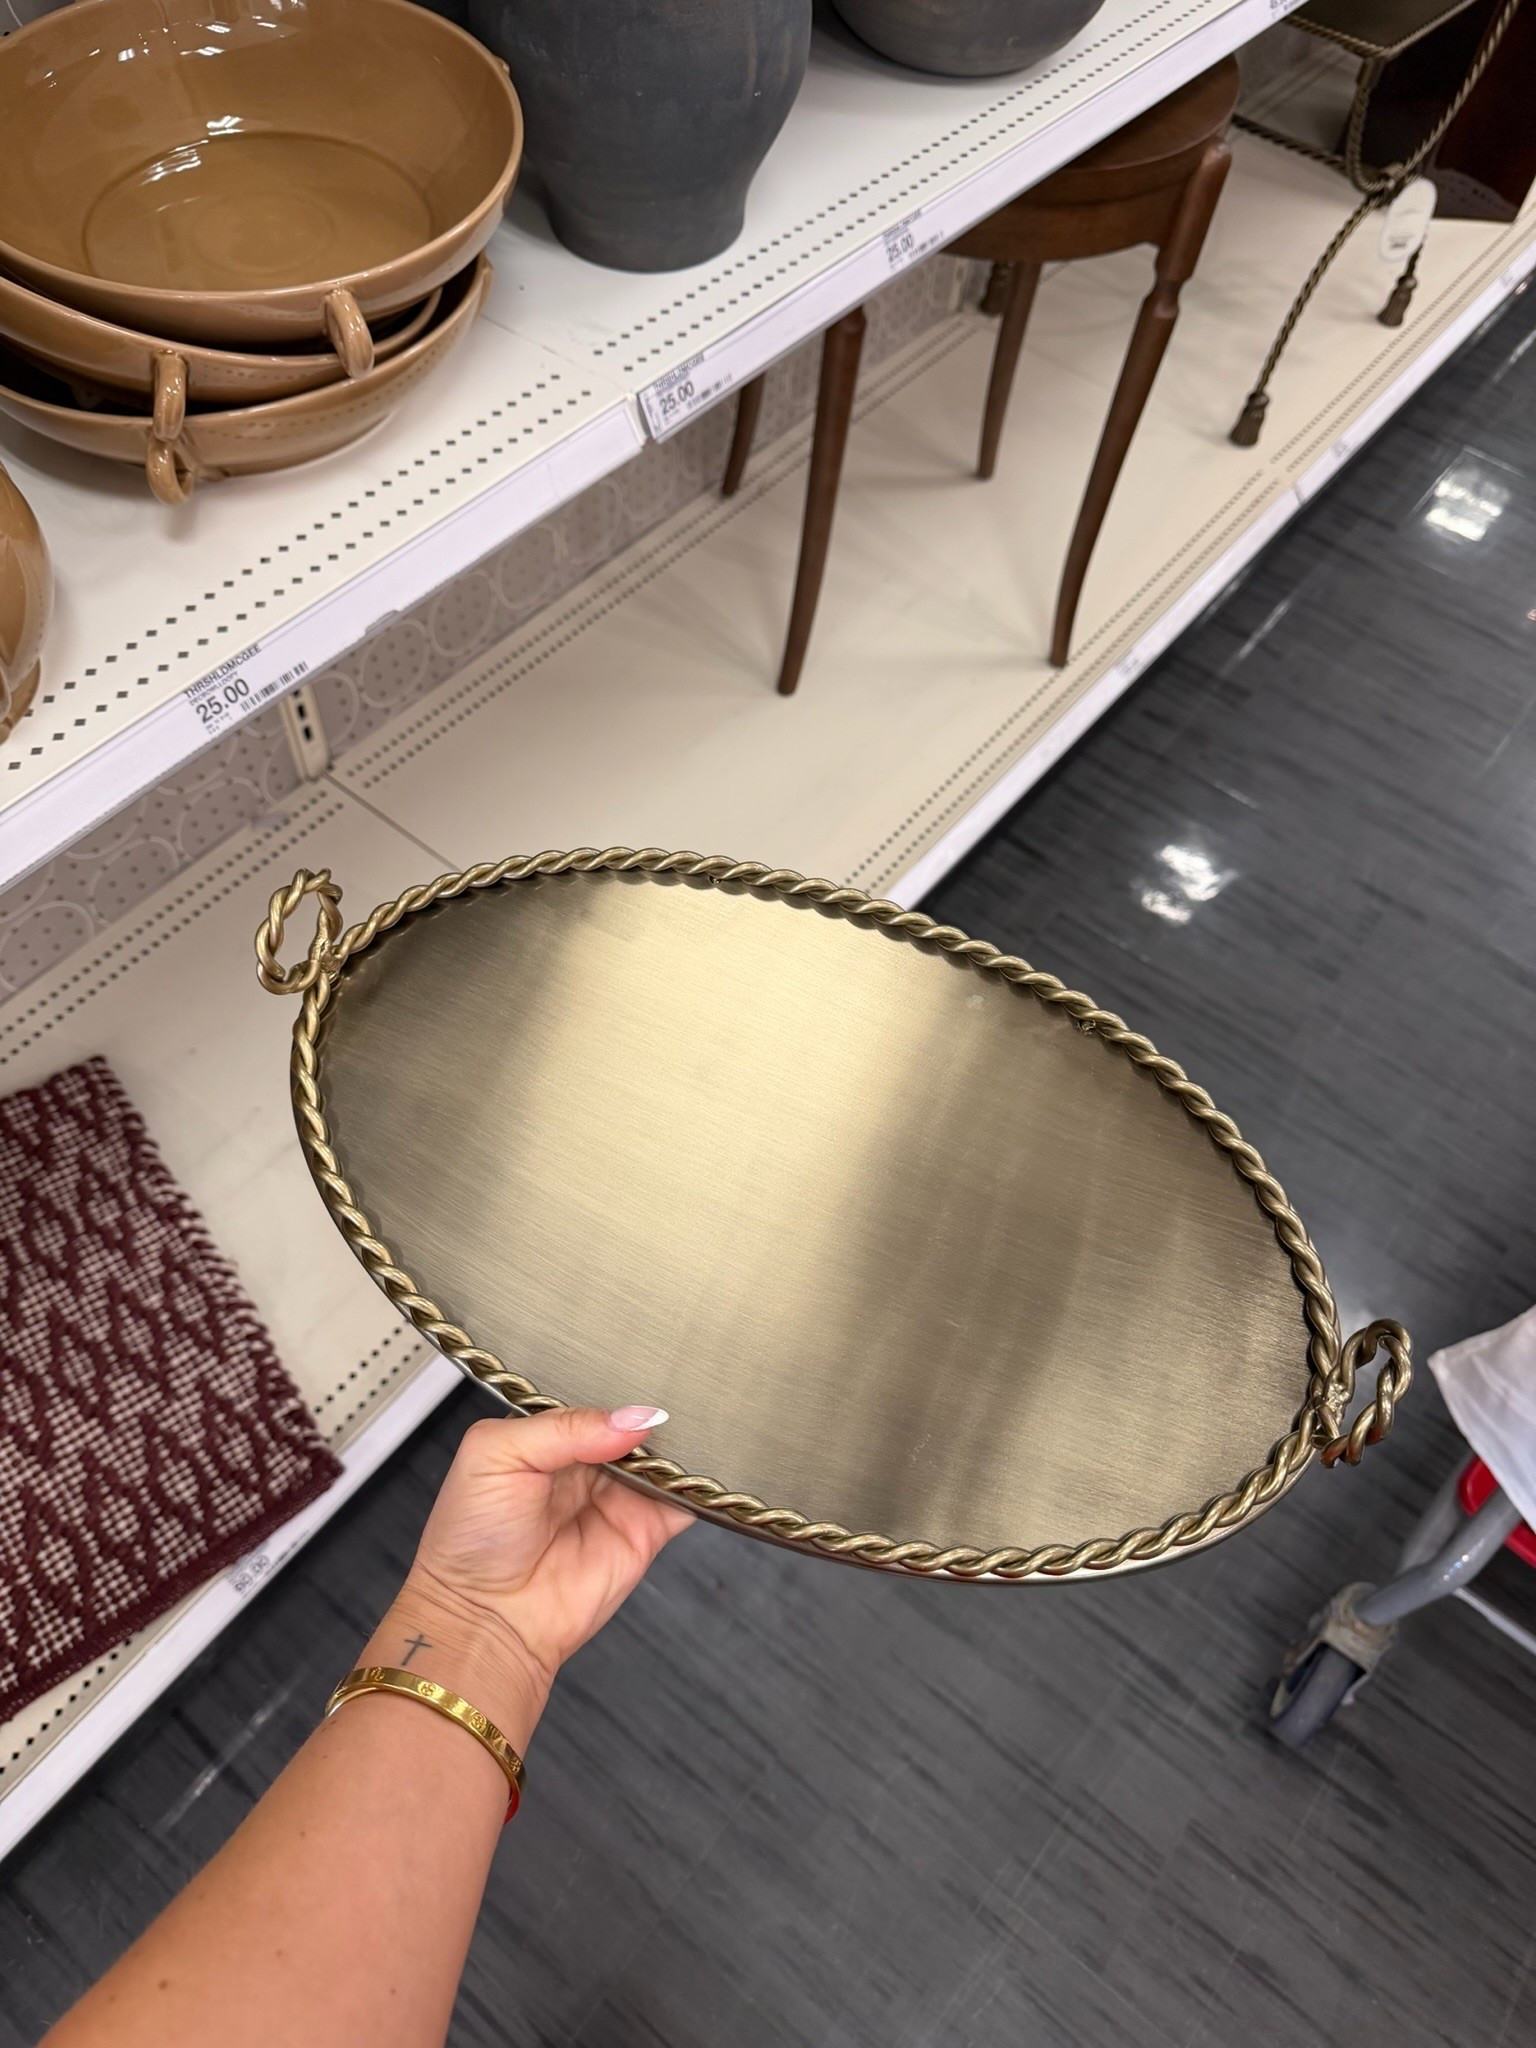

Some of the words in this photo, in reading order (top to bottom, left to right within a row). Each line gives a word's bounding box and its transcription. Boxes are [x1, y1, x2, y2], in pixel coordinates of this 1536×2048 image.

[660, 381, 695, 415] 25.00
[184, 643, 262, 699] THRSHLDMCGEE
[196, 678, 249, 723] 25.00
